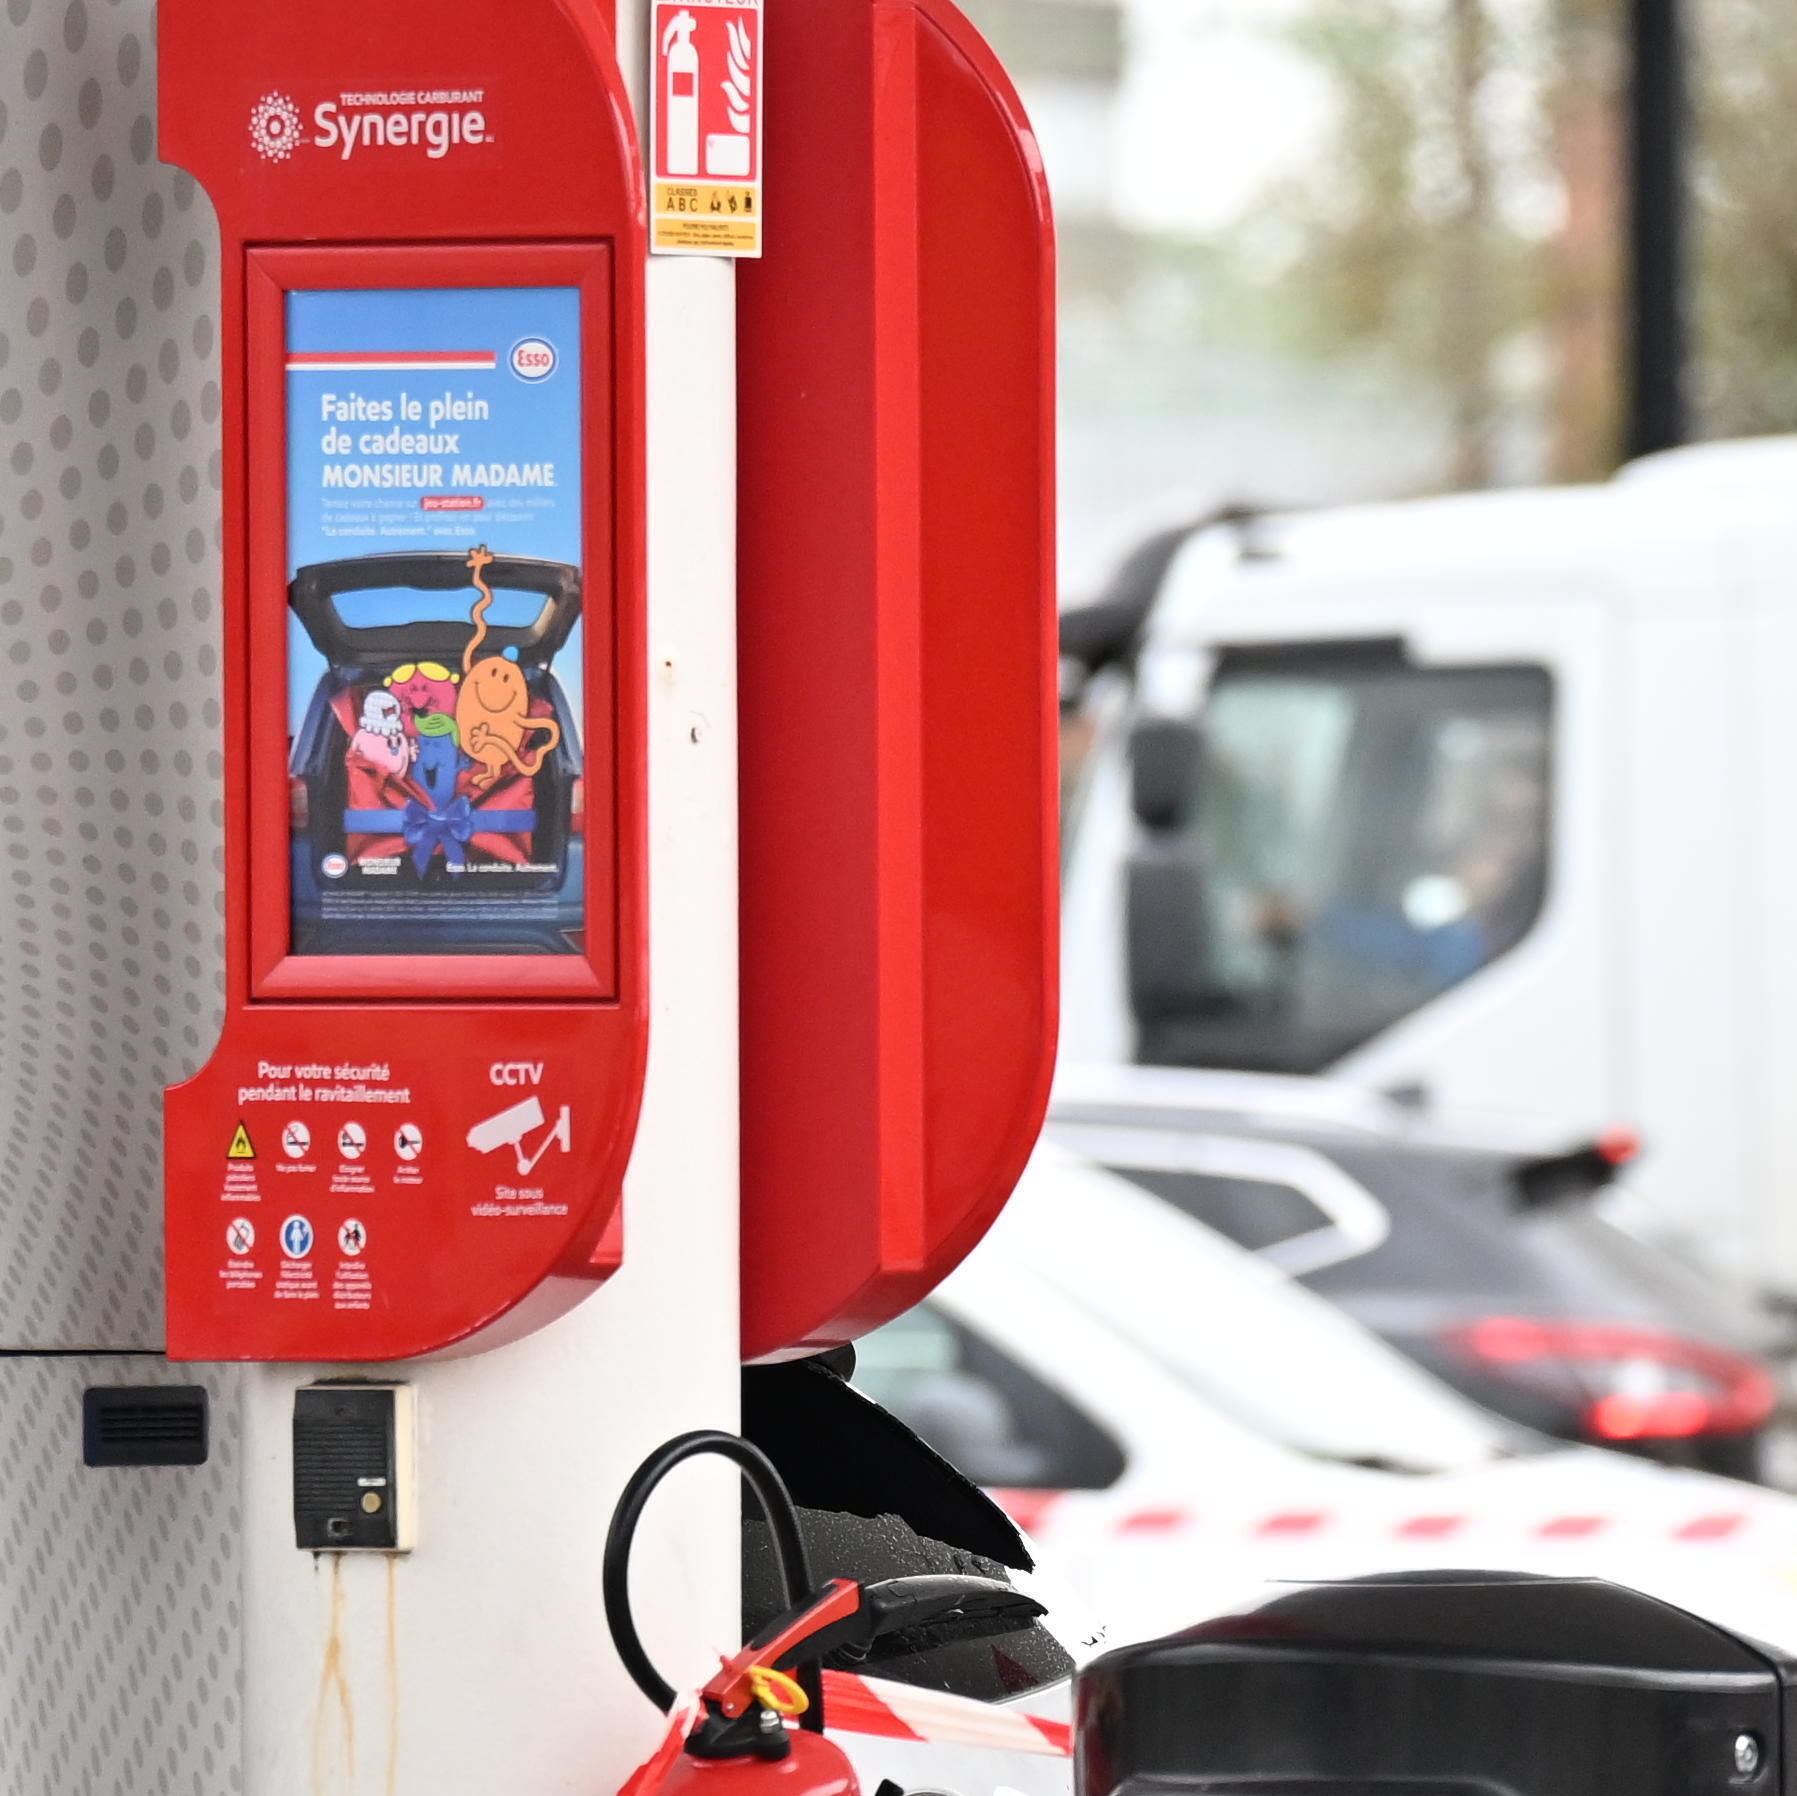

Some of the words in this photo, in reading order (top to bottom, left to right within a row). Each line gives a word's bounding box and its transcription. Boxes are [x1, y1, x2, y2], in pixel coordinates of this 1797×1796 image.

[313, 101, 486, 160] Synergie
[515, 348, 550, 370] Esso
[321, 392, 393, 422] Faites
[400, 391, 422, 421] le
[429, 391, 489, 429] plein
[321, 426, 352, 455] de
[359, 425, 460, 455] cadeaux
[322, 463, 444, 488] MONSIEUR
[451, 463, 555, 488] MADAME
[257, 1061, 292, 1079] Pour
[294, 1063, 332, 1080] votre
[334, 1062, 390, 1081] sécurité
[489, 1062, 544, 1086] CCTV
[237, 1082, 297, 1106] pendant
[299, 1083, 313, 1102] le
[314, 1084, 411, 1104] ravitaillement
